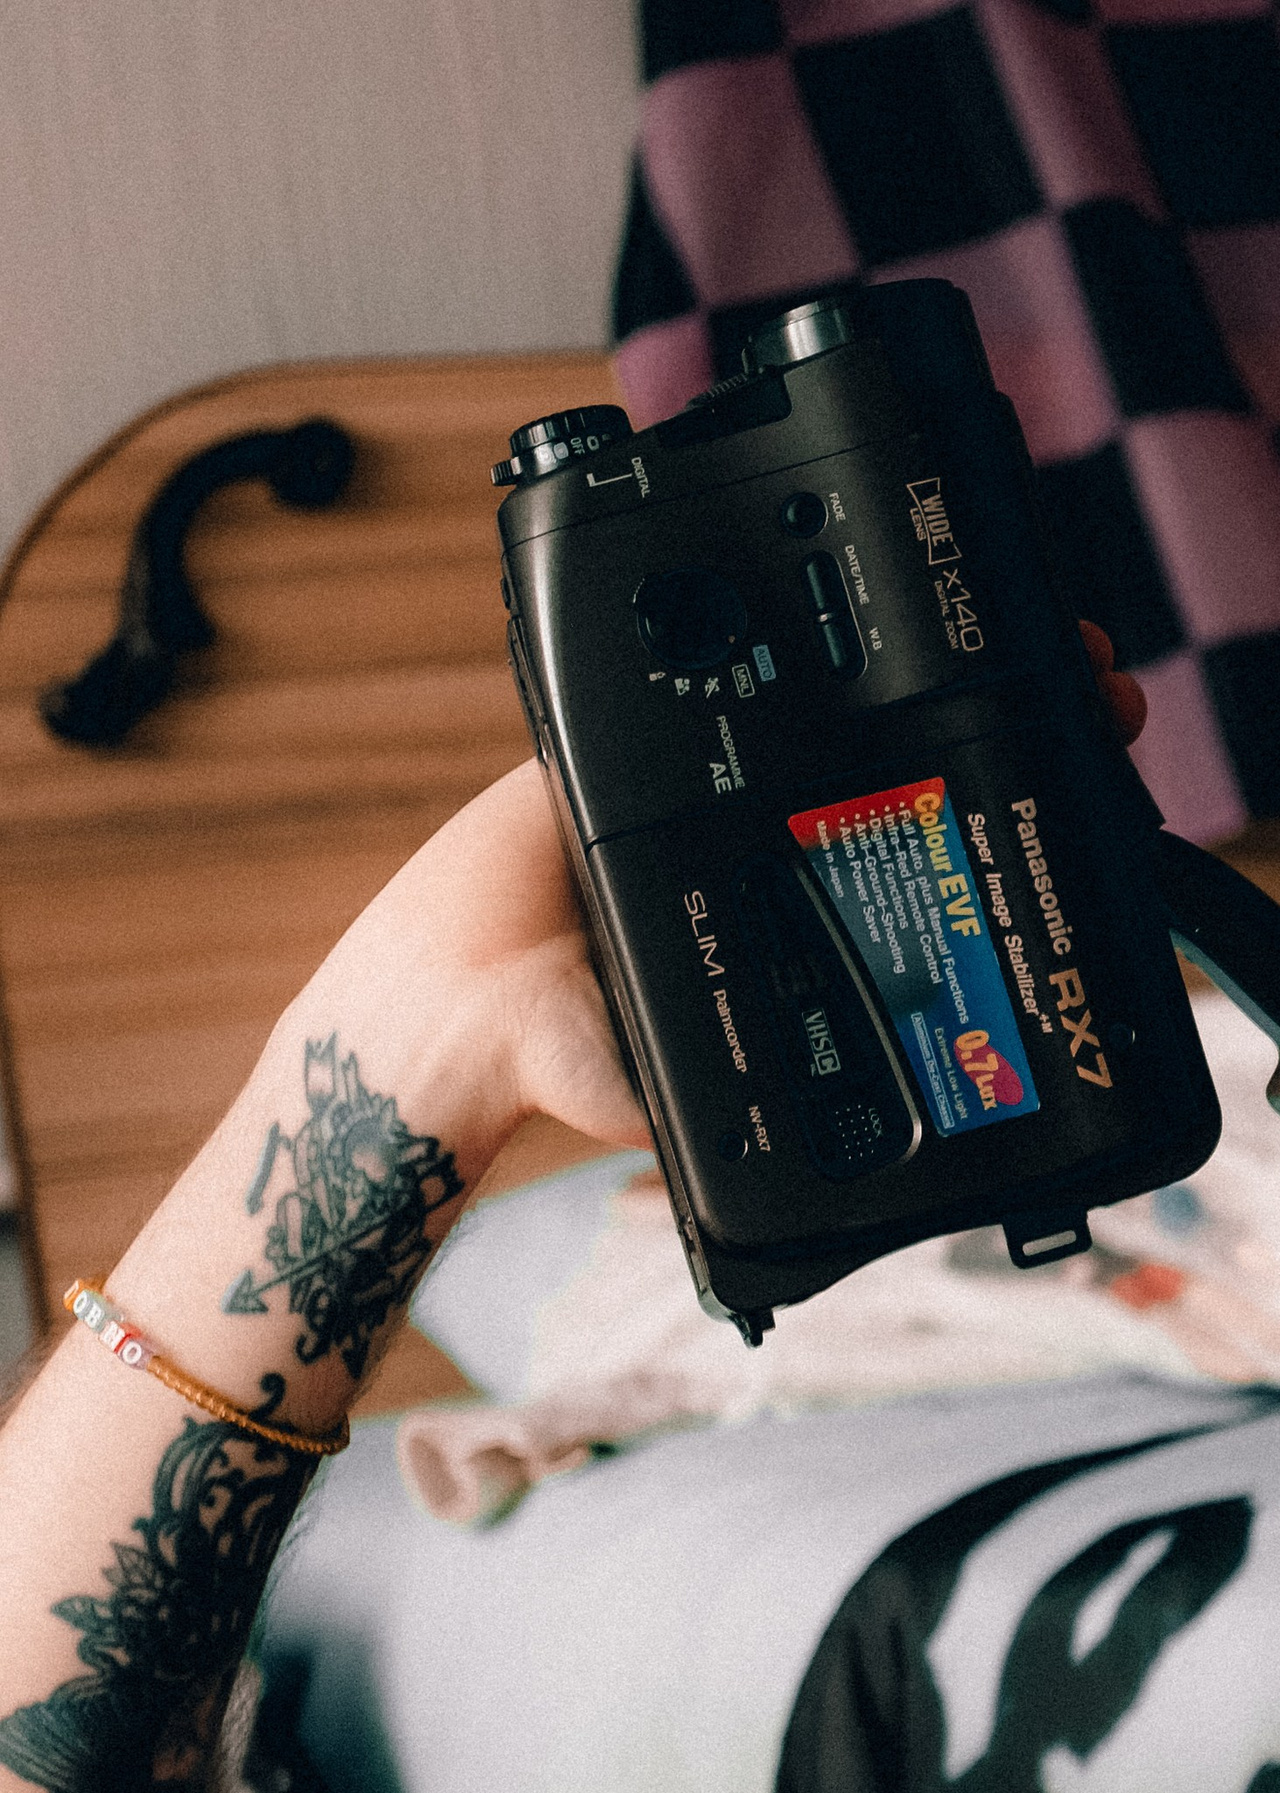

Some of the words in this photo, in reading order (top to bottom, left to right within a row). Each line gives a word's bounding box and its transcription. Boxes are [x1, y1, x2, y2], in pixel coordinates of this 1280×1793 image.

[570, 437, 584, 456] OFF
[631, 457, 650, 498] DIGITAL
[829, 493, 845, 523] FADE
[909, 507, 926, 542] LENS
[922, 494, 953, 547] WIDE
[845, 545, 869, 606] DATE/TIME
[868, 627, 882, 651] W.B
[934, 580, 950, 617] DIGITAL
[945, 620, 959, 650] ZOOM
[735, 668, 750, 694] MNL
[756, 647, 771, 679] AUTO
[709, 759, 731, 795] AE
[716, 715, 745, 790] PROGRAMME
[816, 820, 831, 851] Made
[899, 809, 915, 836] Full
[825, 852, 835, 864] in
[868, 818, 890, 861] Digital
[882, 863, 909, 930] Functions
[906, 837, 924, 874] Auto.
[915, 791, 952, 871] Colour
[938, 873, 981, 935] EVF
[966, 811, 996, 868] Super
[984, 871, 1013, 929] Image
[827, 865, 844, 899] Japan
[838, 826, 856, 859] Auto
[850, 861, 869, 903] Power
[862, 905, 881, 944] Saver
[854, 822, 906, 975] Anti-Ground-Shooting
[883, 814, 911, 879] Infra-Red
[904, 880, 926, 933] Remote
[919, 934, 942, 985] Control
[915, 875, 934, 906] plus
[927, 907, 950, 956] Manual
[1011, 798, 1075, 957] Panasonic
[1048, 967, 1112, 1094] RX7
[683, 890, 725, 977] SLIM
[713, 989, 748, 1075] Palmcorder
[942, 957, 970, 1025] Functions
[935, 1027, 952, 1069] Extreme
[947, 1071, 959, 1092] Low
[953, 1093, 968, 1120] Light
[747, 1105, 770, 1154] NV-RX7
[868, 1107, 884, 1139] LOCK
